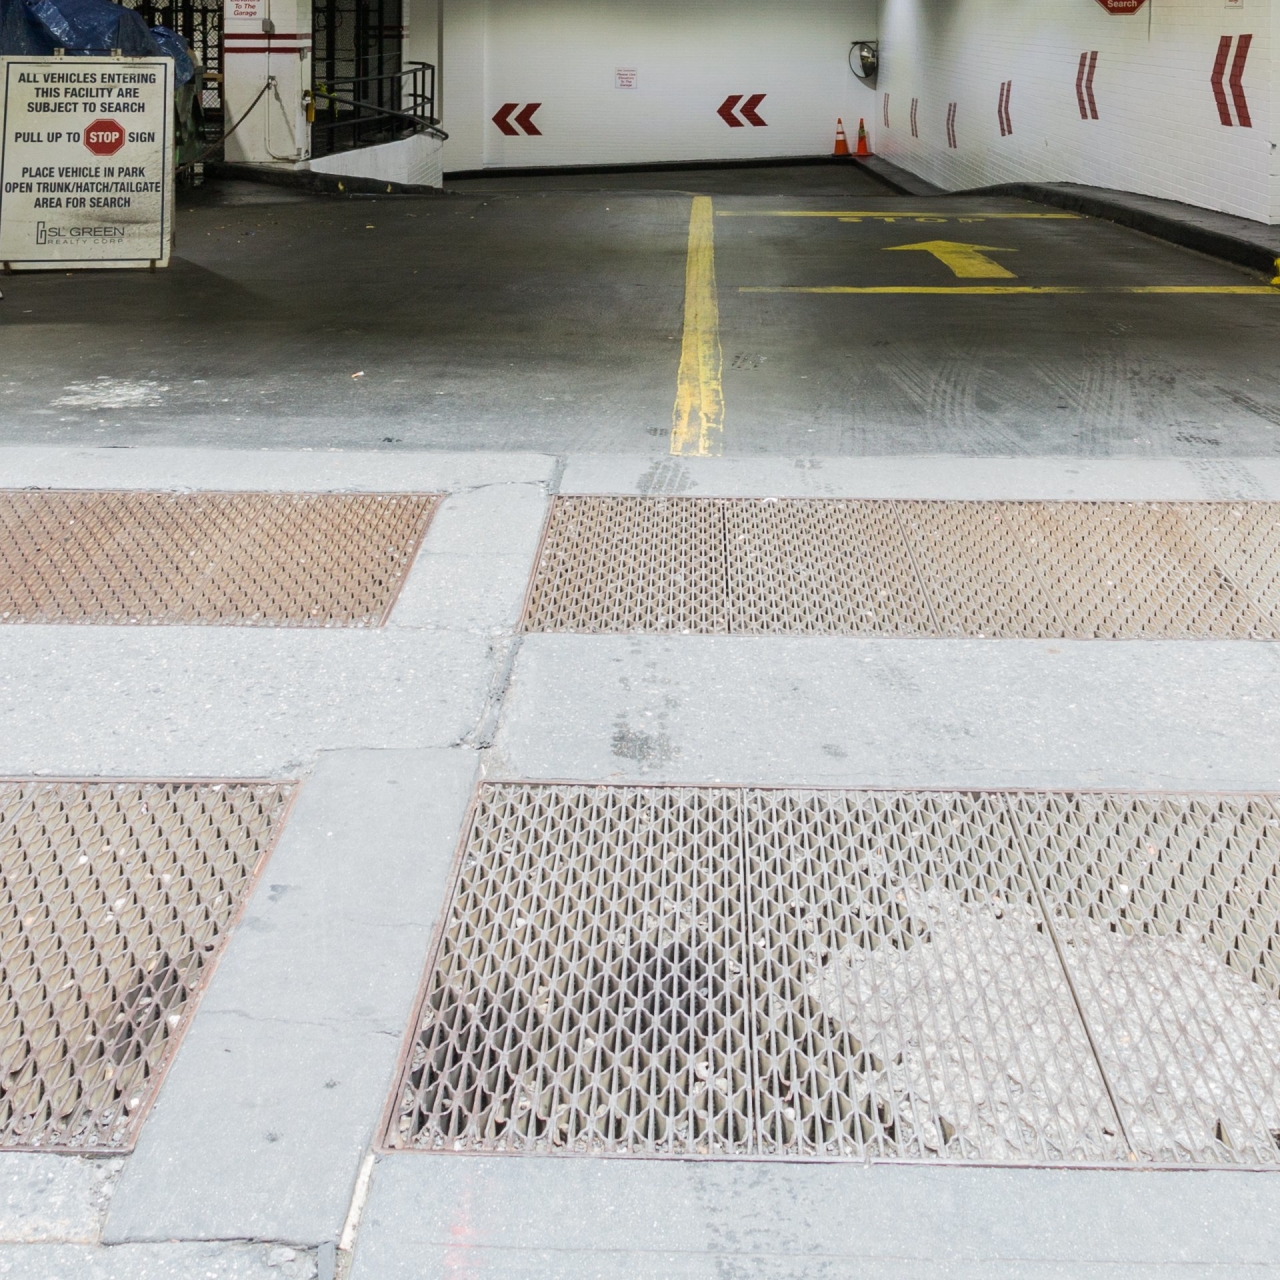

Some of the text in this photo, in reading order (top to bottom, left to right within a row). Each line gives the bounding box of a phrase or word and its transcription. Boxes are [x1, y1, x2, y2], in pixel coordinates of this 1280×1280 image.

[1107, 0, 1137, 8] Search
[18, 72, 157, 84] ALL VEHICLES ENTERING
[34, 87, 140, 98] THIS FACILITY ARE
[27, 102, 146, 113] SUBJECT TO SEARCH
[14, 131, 156, 143] PULL UP TO STOP SIGN
[22, 167, 146, 178] PLACE VEHICLE IN PARK
[5, 181, 161, 193] OPEN TRUNK/HATCH/TAILGATE
[34, 197, 131, 208] AREA FOR SEARCH
[48, 226, 125, 237] SL GREEN
